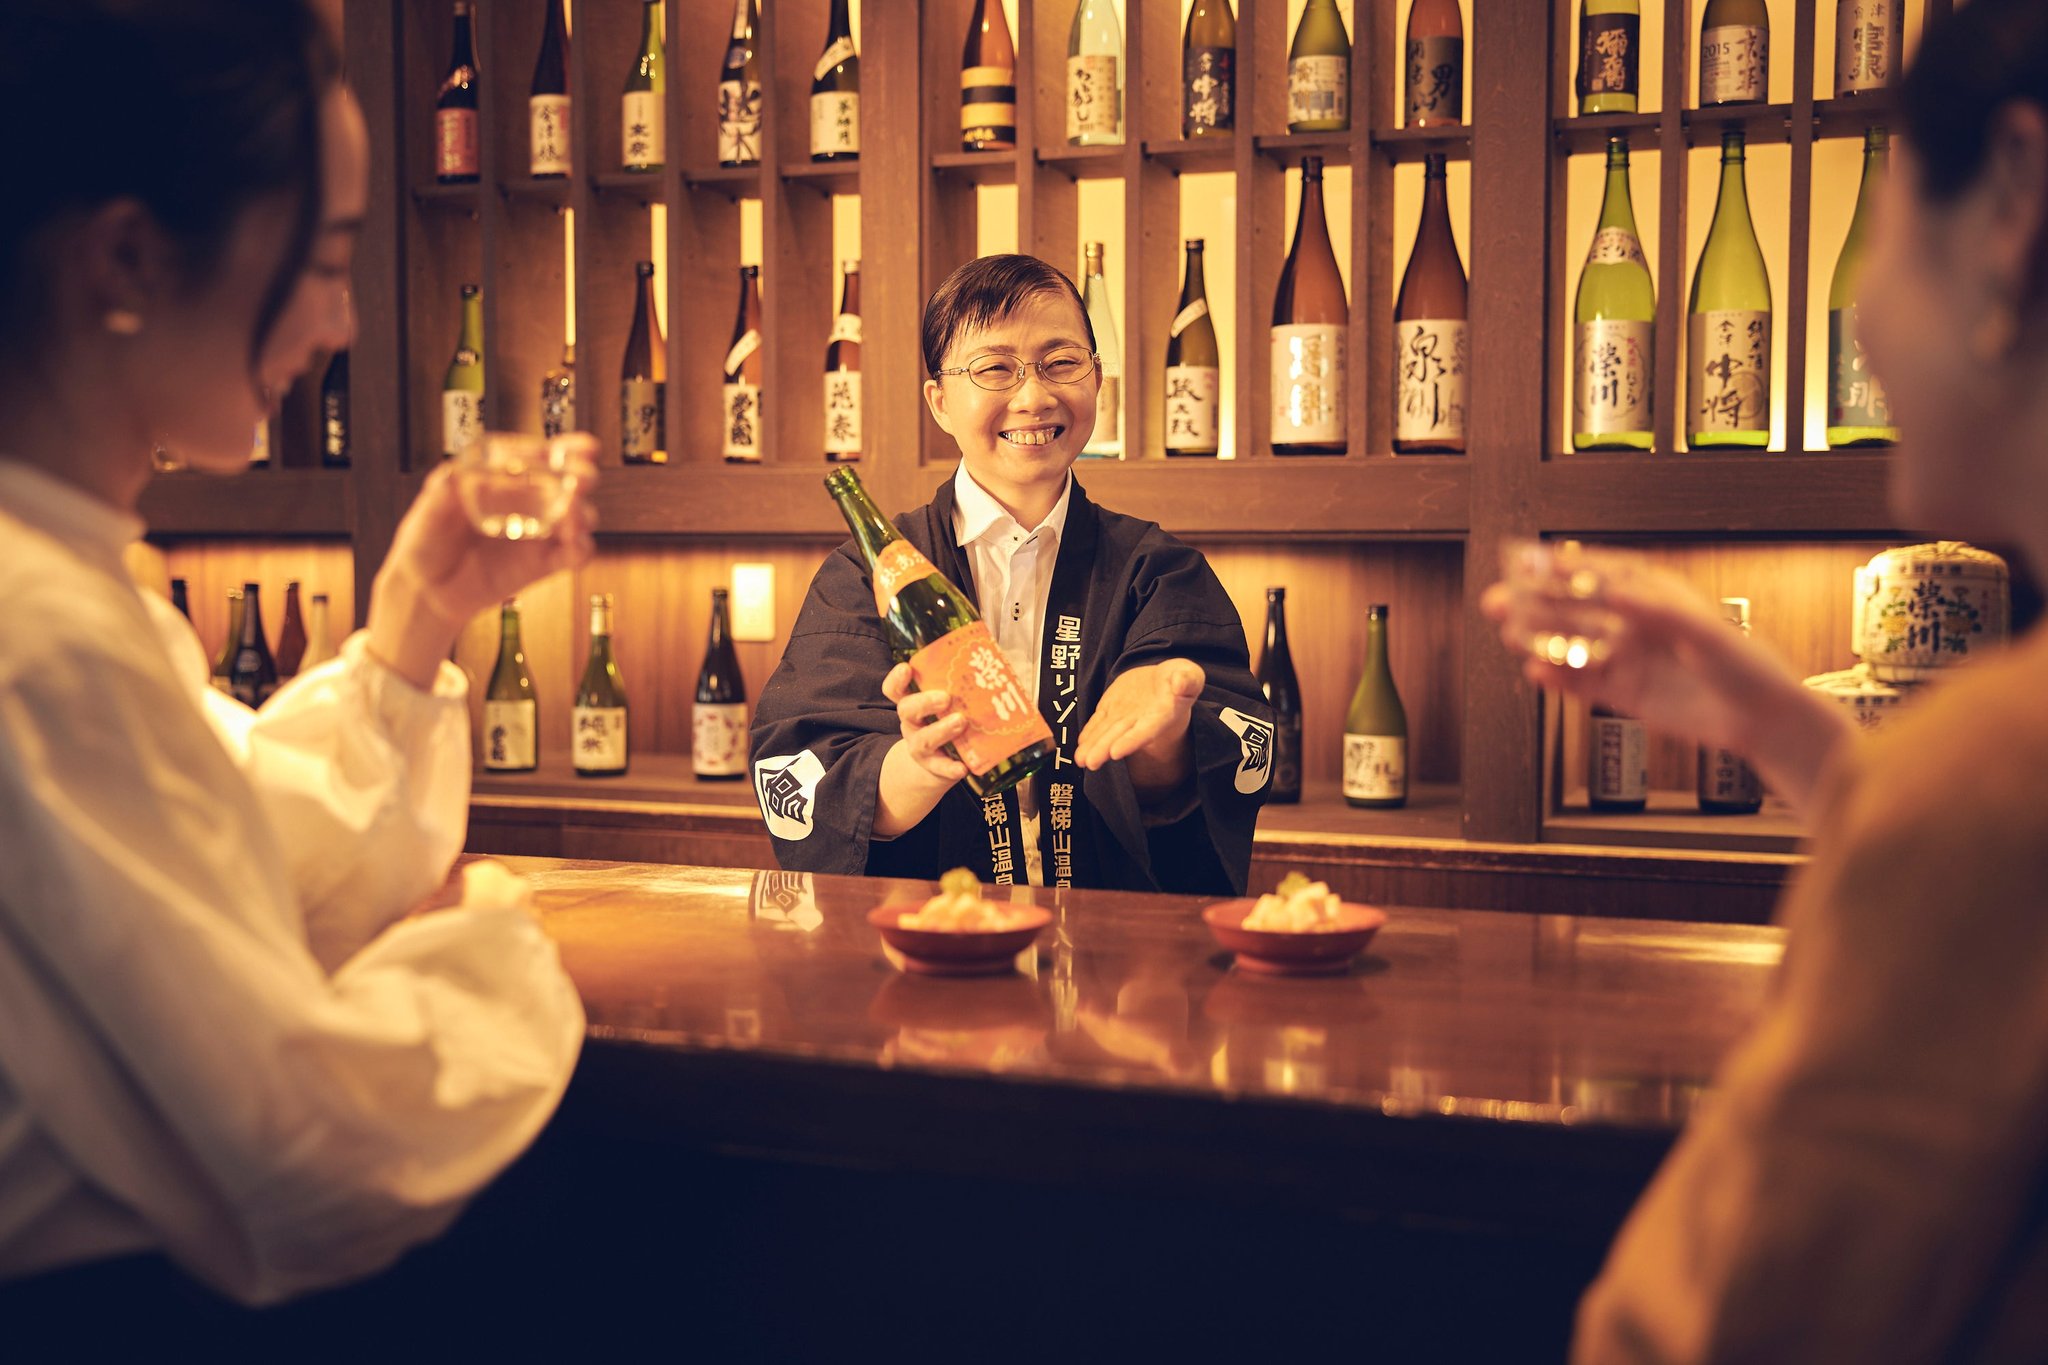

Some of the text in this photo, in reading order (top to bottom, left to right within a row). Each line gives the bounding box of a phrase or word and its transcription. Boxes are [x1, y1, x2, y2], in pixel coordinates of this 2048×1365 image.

[1703, 42, 1731, 58] 2015
[1406, 326, 1447, 432] 泉川
[1050, 614, 1081, 770] 星野リゾート
